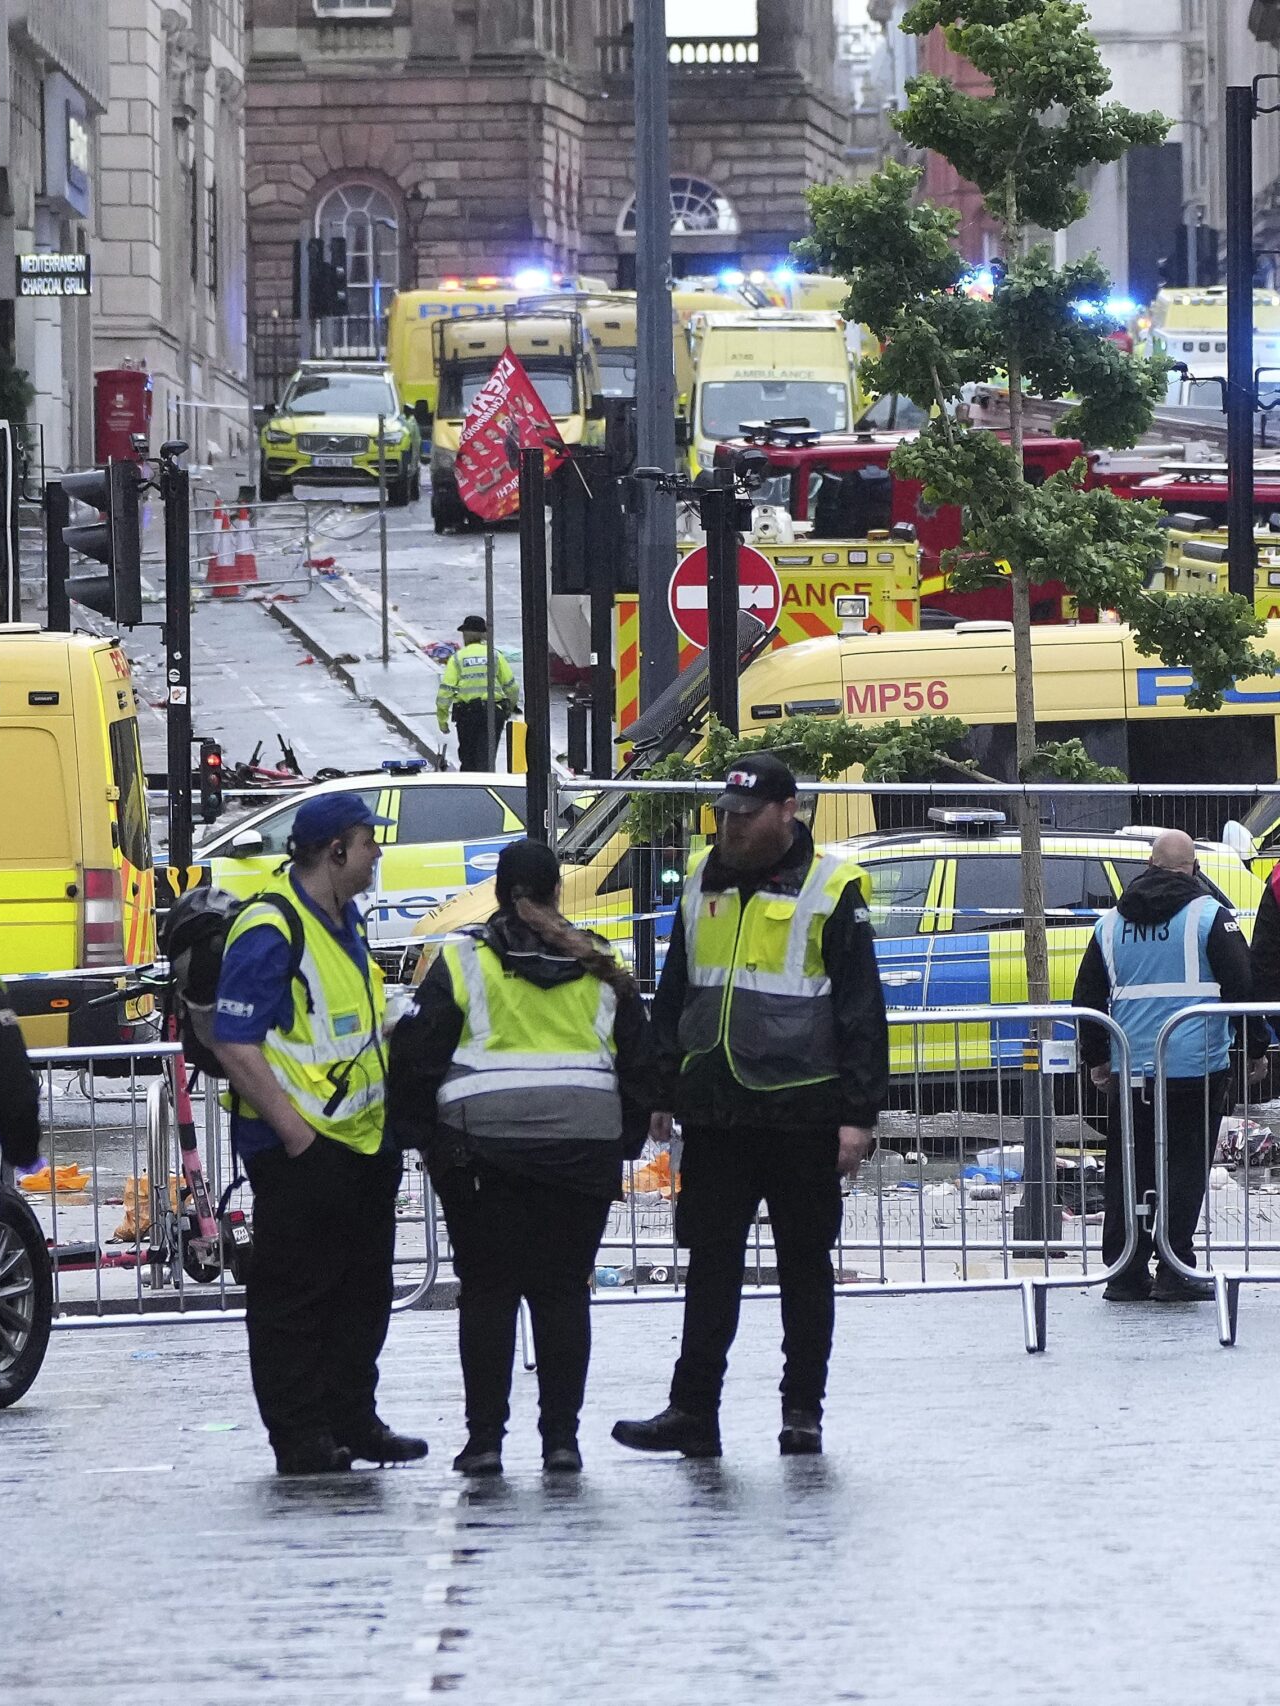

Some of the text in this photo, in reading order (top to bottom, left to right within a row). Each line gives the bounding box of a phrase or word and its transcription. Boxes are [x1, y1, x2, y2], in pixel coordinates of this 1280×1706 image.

[21, 254, 86, 272] MEDITERRANEAN
[21, 276, 87, 295] CHARCOAL GRILL
[734, 370, 815, 379] AMBULANCE
[846, 680, 949, 714] MP56
